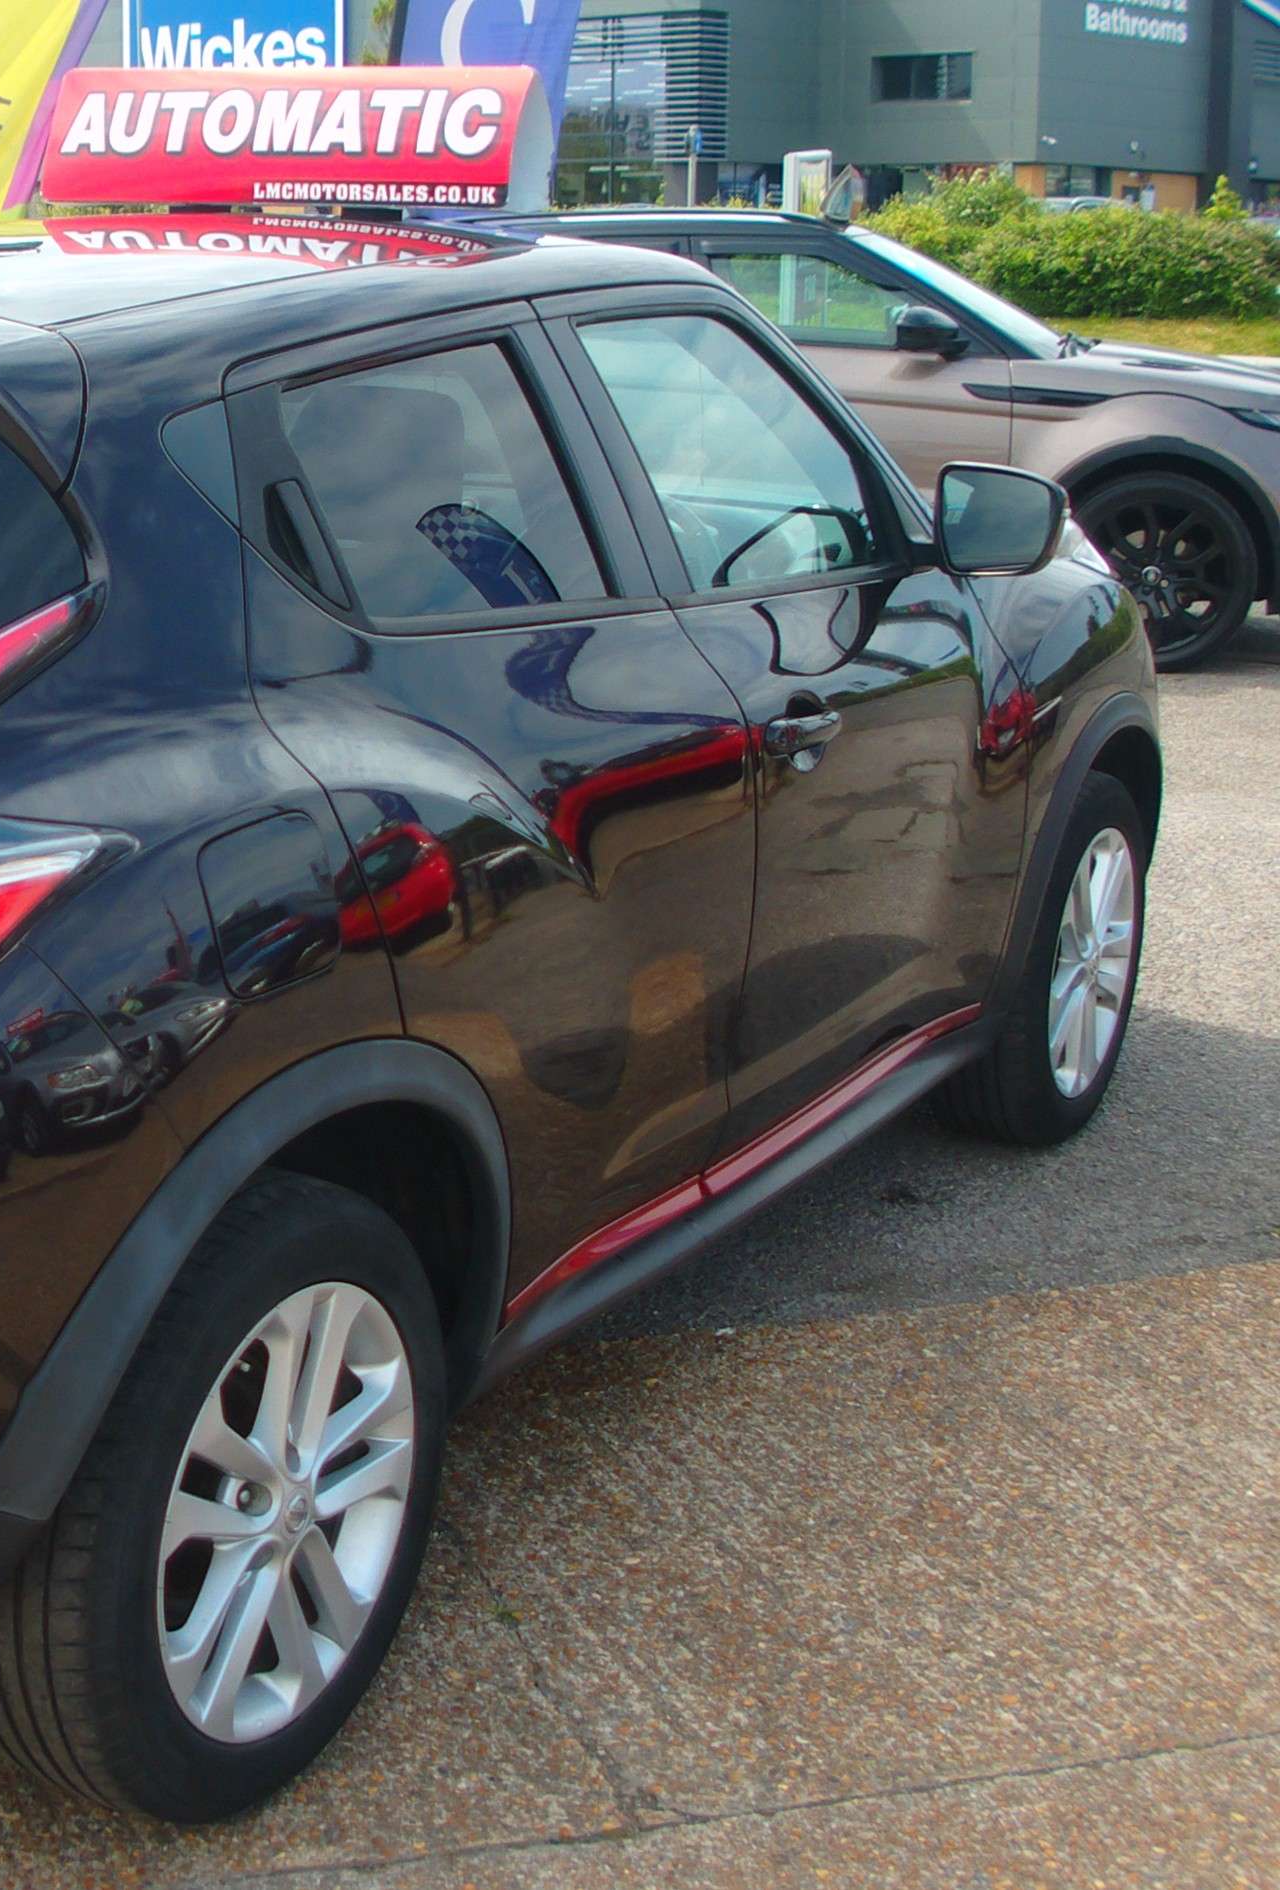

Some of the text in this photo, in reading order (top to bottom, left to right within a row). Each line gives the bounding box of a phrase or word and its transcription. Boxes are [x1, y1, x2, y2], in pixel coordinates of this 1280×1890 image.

[140, 18, 327, 69] Wickes
[1086, 2, 1188, 43] Bathrooms
[61, 88, 502, 156] AUTOMATIC
[253, 182, 496, 205] LMCMOTORSALES.CO.UK
